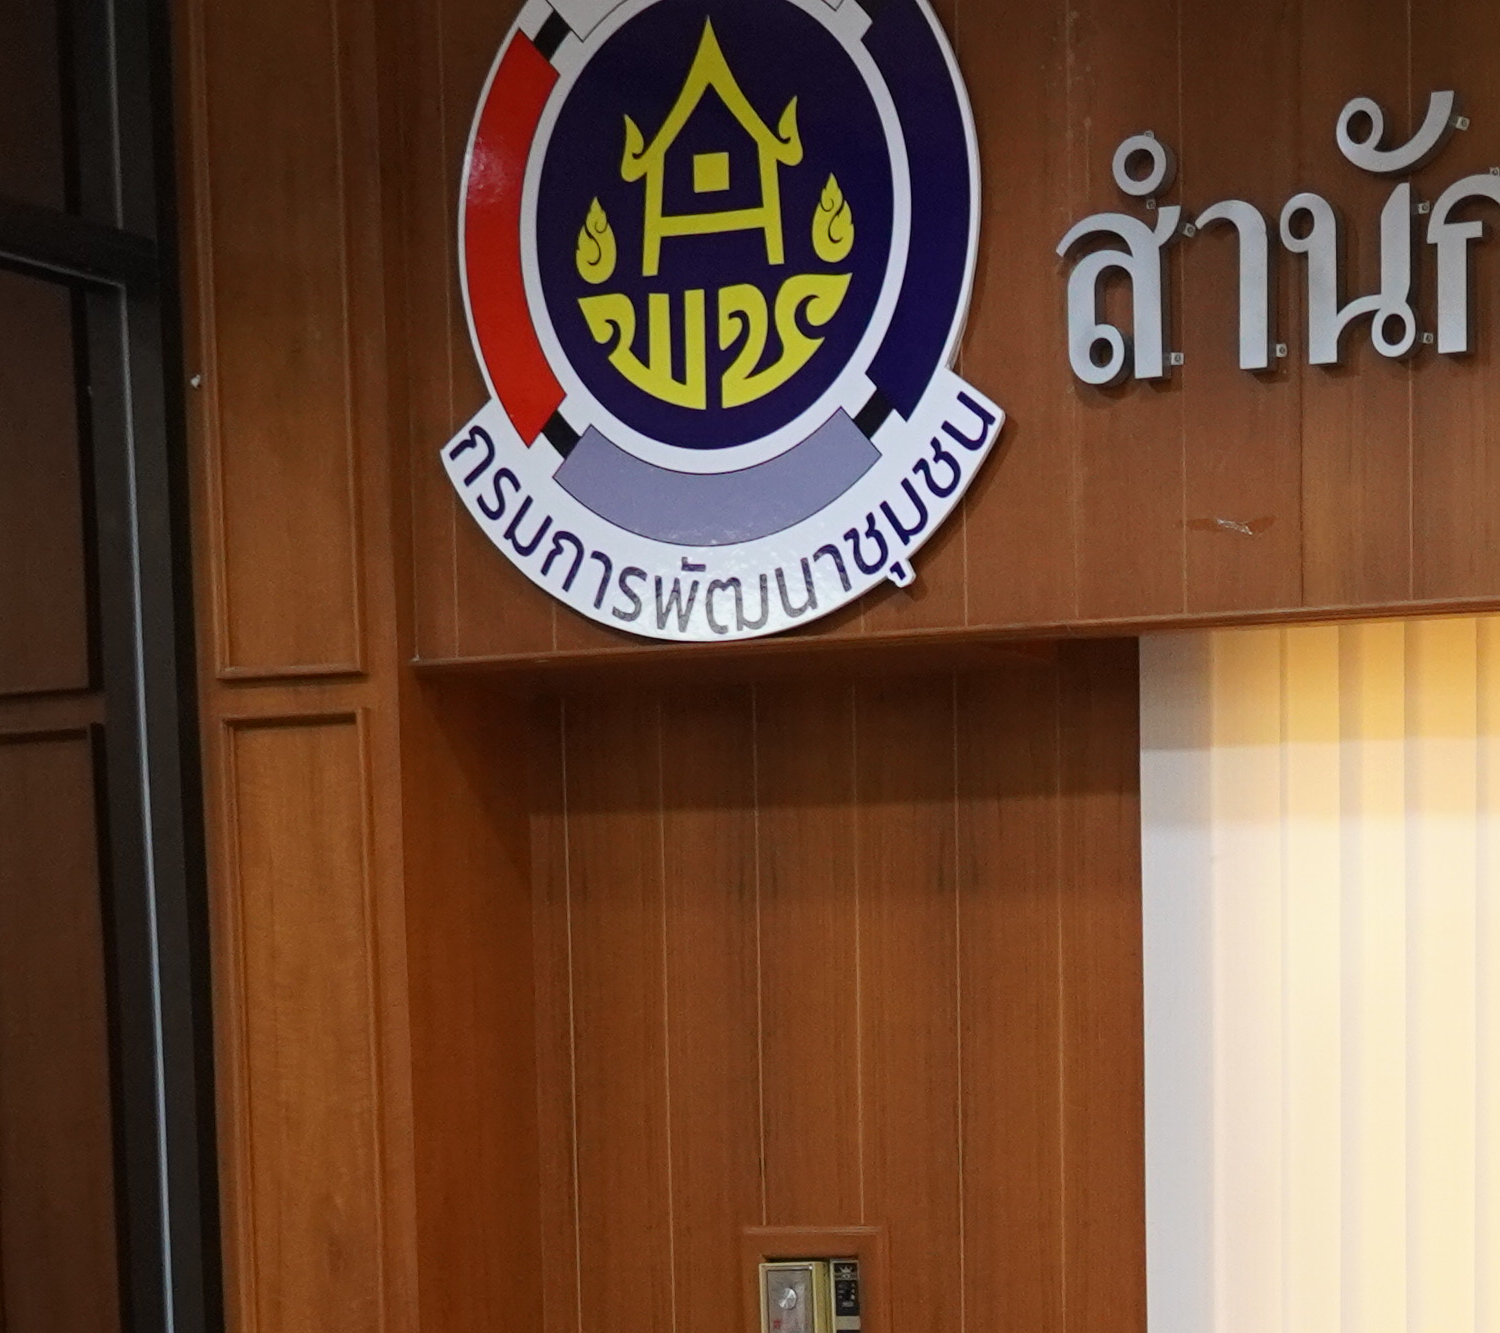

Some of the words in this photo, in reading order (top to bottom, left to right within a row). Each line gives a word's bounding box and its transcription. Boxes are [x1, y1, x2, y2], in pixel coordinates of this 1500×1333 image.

[449, 390, 997, 635] กรมการพัฒนาชุมชน
